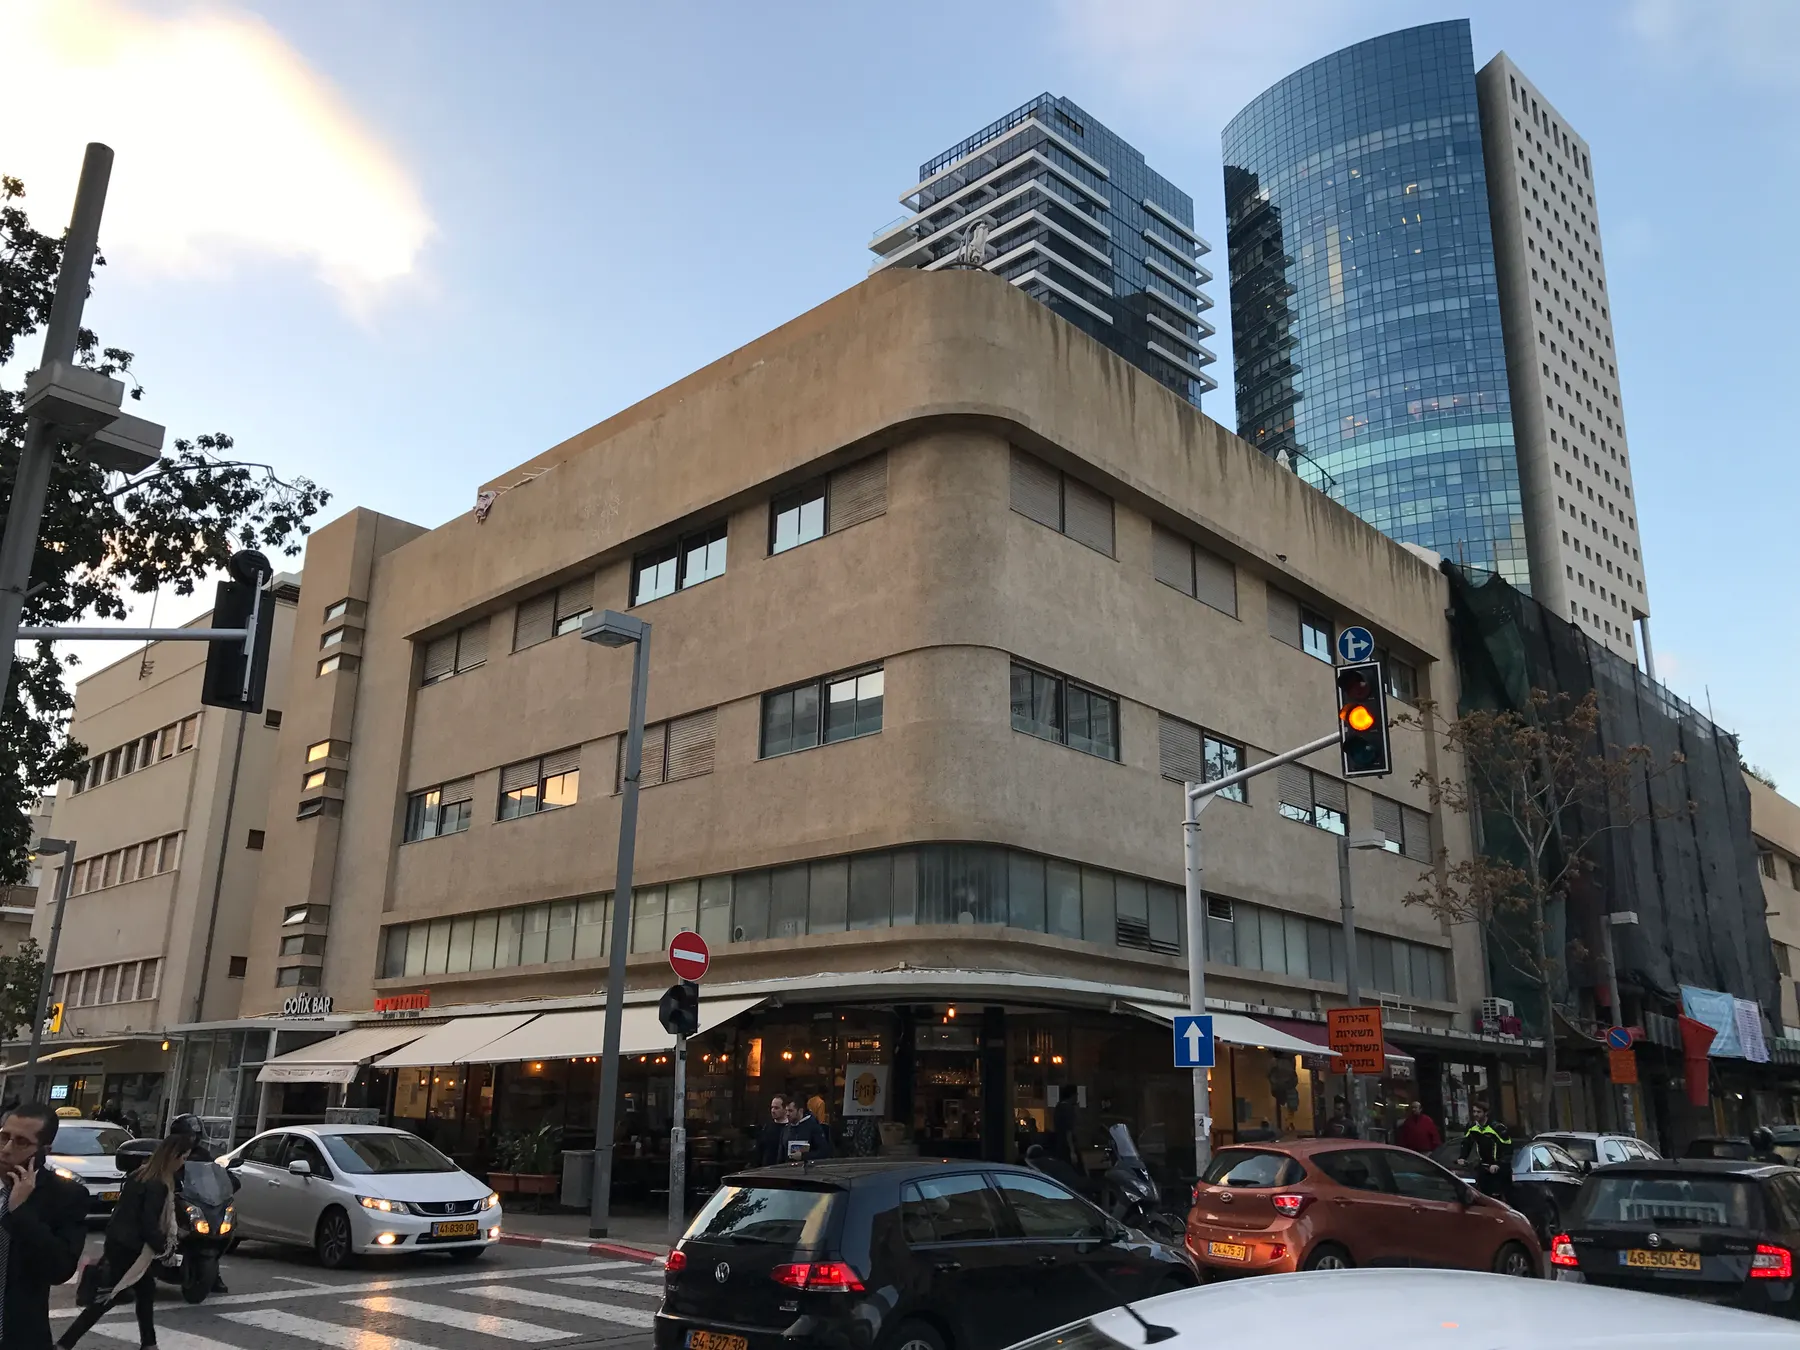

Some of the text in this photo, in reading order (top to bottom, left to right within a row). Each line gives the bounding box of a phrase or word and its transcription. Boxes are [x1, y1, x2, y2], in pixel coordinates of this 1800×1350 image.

[312, 996, 331, 1013] BAR
[1337, 1014, 1370, 1023] זהירות
[1336, 1028, 1374, 1038] משאיות
[1333, 1043, 1380, 1053] משתלבות
